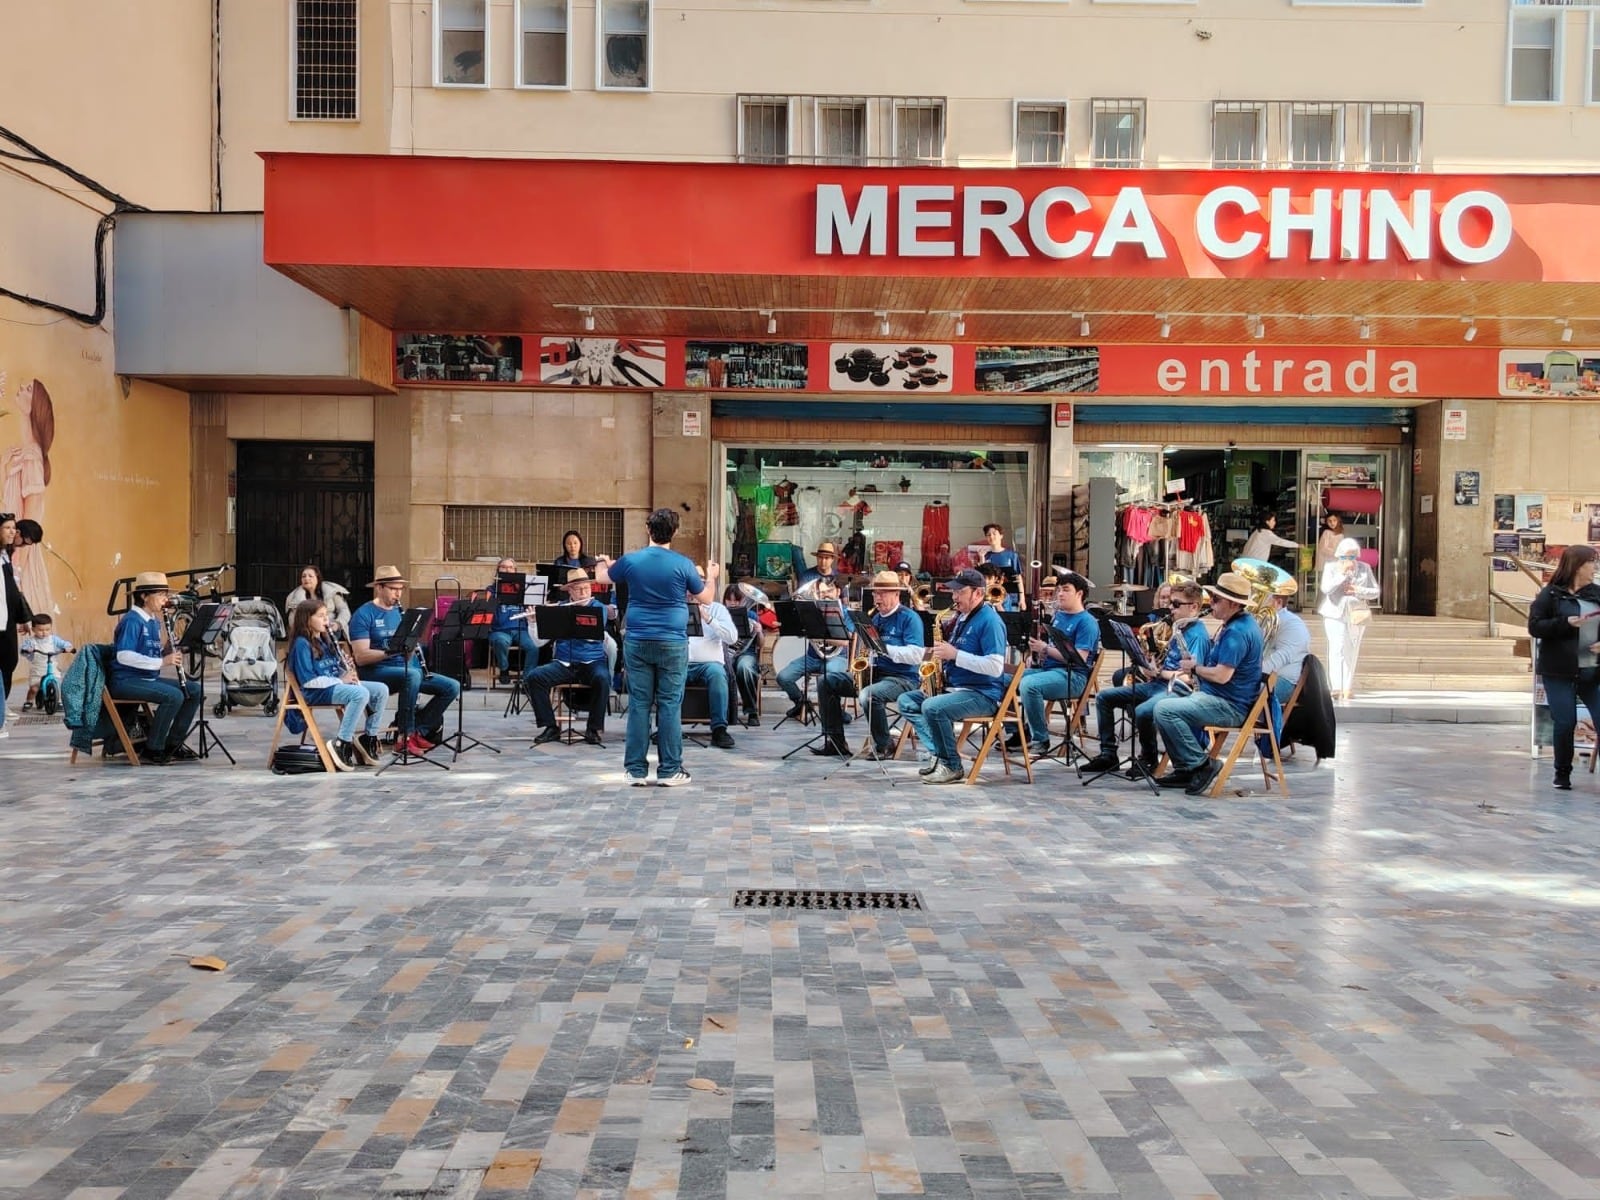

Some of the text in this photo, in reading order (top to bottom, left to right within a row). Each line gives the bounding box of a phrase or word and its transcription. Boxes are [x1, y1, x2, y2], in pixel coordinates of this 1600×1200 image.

[814, 183, 1514, 265] MERCA CHINO
[1156, 349, 1419, 394] entrada
